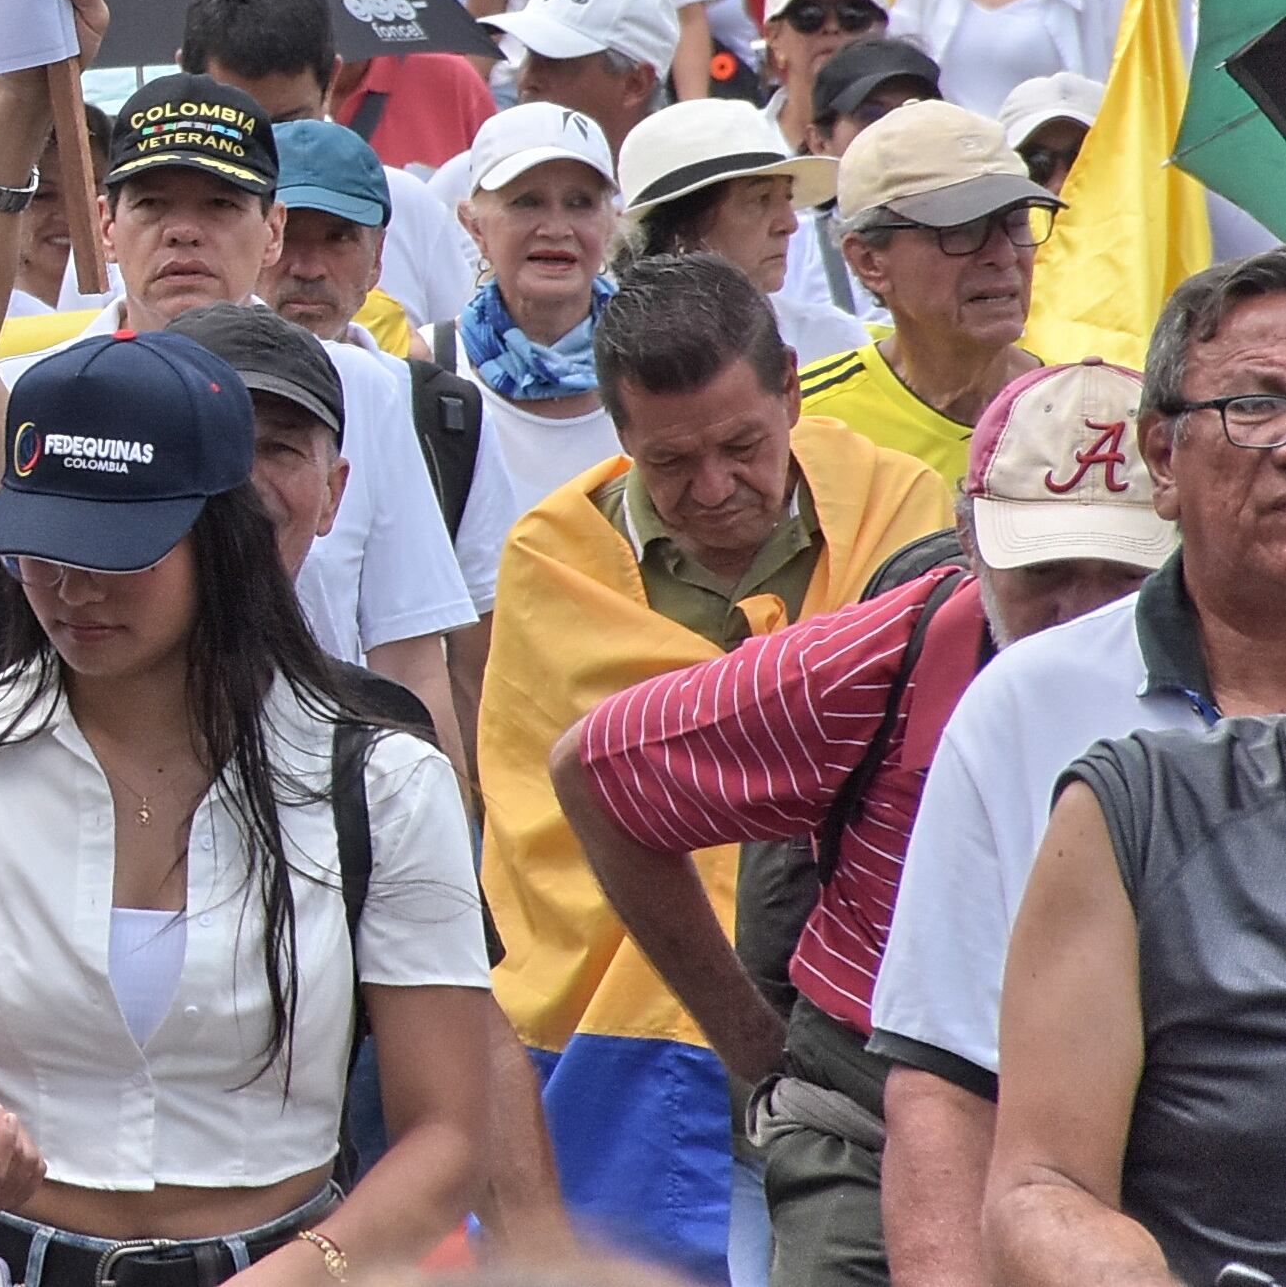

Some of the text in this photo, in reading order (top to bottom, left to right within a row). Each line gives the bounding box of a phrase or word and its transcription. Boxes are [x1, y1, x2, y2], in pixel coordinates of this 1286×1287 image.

[130, 102, 256, 136] COLOMBIA
[136, 132, 246, 158] VETERANO
[44, 433, 154, 464] FEDEQUINAS
[1044, 418, 1129, 494] A
[63, 457, 129, 474] COLOMBIA
